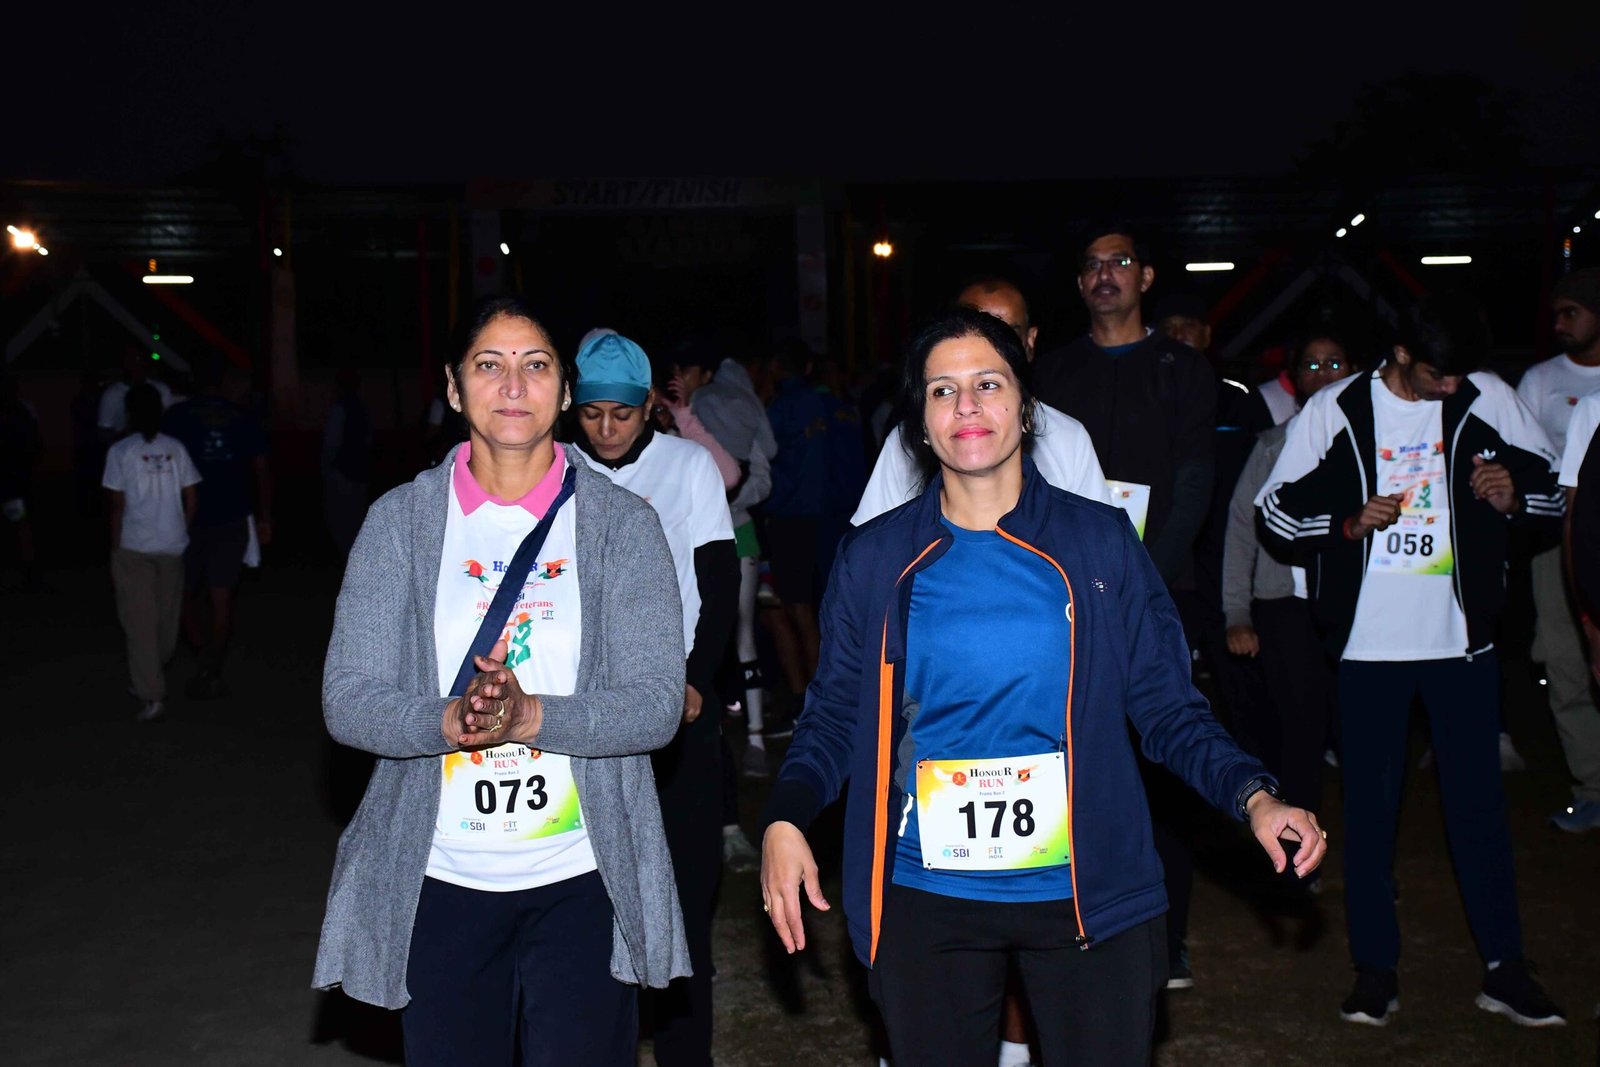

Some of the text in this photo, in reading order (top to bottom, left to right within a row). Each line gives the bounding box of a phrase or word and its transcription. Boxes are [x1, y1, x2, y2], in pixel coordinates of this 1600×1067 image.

[551, 179, 744, 205] START/FINISH
[1386, 532, 1433, 557] 058
[485, 746, 526, 759] HONOUR
[493, 758, 518, 769] RUN
[970, 766, 1012, 778] HONOUR
[979, 778, 1004, 788] RUN
[474, 774, 549, 815] 073
[958, 798, 1035, 839] 178
[469, 821, 486, 831] SBI
[952, 848, 970, 858] SBI
